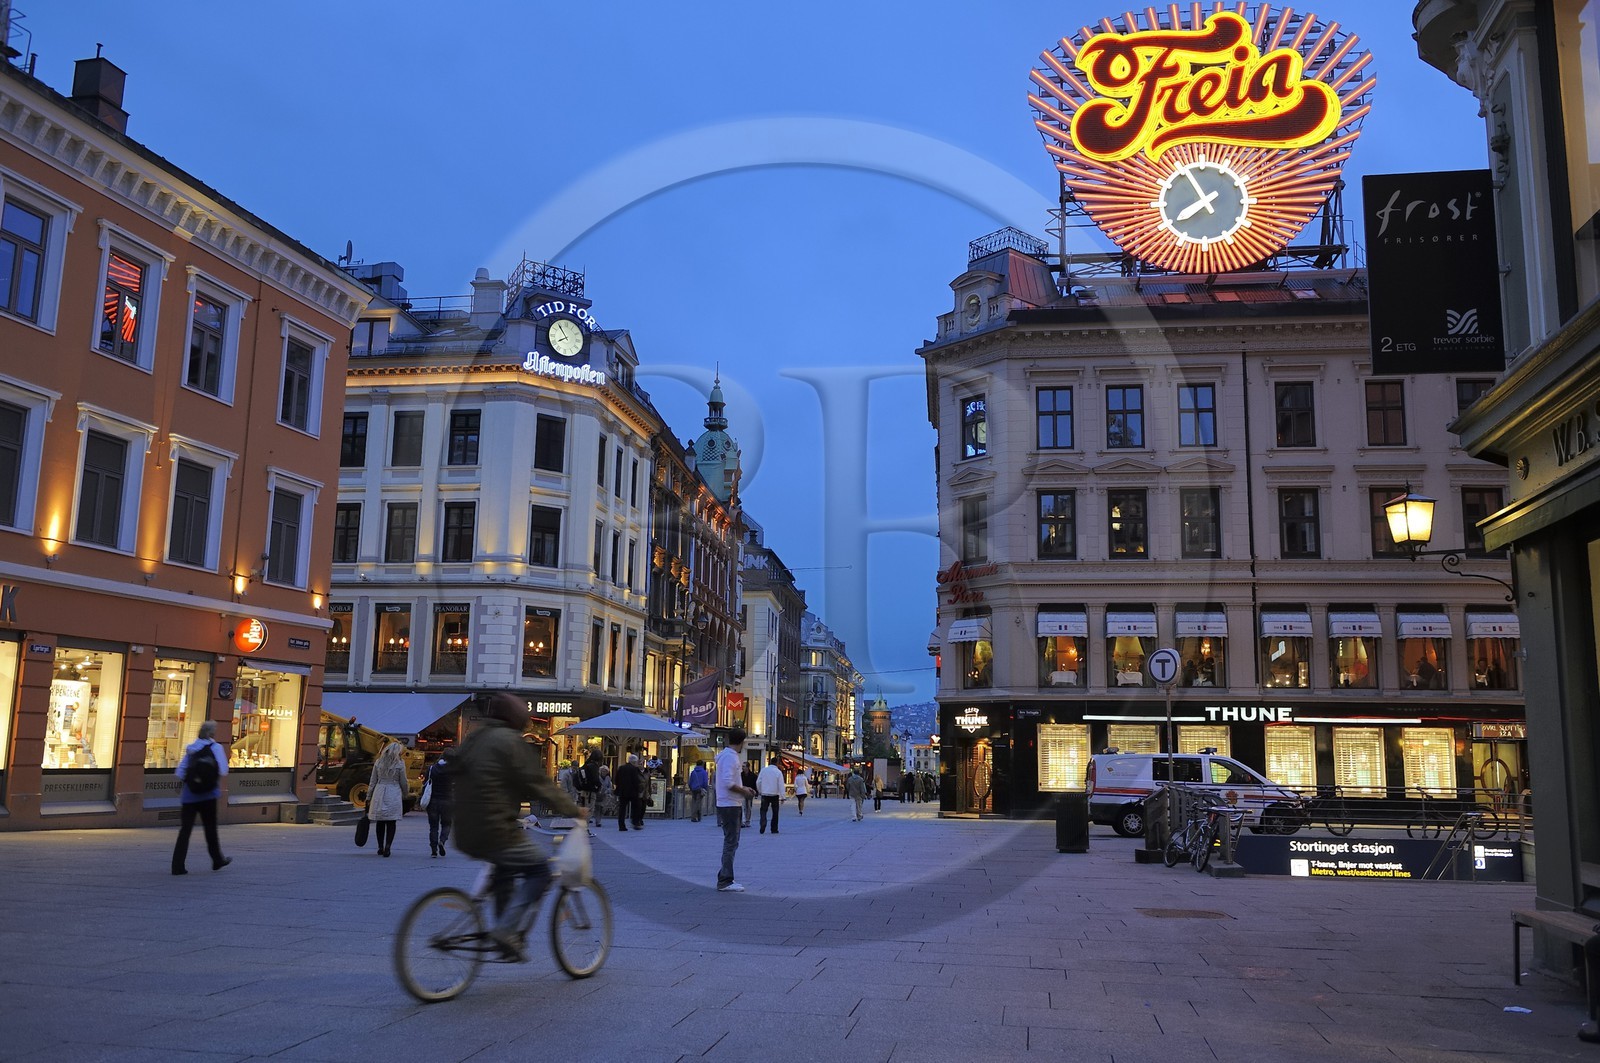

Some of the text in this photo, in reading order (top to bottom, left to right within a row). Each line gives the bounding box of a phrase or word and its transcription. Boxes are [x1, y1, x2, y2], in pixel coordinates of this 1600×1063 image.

[1070, 12, 1341, 163] Freia
[1376, 190, 1478, 238] frost
[1384, 235, 1478, 244] FRISØRER
[537, 300, 596, 330] TID FOR
[1380, 337, 1416, 352] 2 ETG
[1433, 335, 1495, 345] trevor sorbie
[523, 351, 606, 385] Aftenposten
[1155, 659, 1171, 678] T
[537, 702, 573, 713] BRØDRE
[1205, 707, 1292, 721] THUNE
[955, 716, 988, 725] THUNE
[44, 783, 103, 793] PRESSEKLUBBEN
[239, 779, 280, 788] PRESSEKLUBBEN
[1289, 841, 1395, 856] Stortinget stasjon
[1310, 860, 1338, 869] T-bane,
[1338, 861, 1358, 870] linjer
[1311, 868, 1412, 878] Metro, west/eastbound lines
